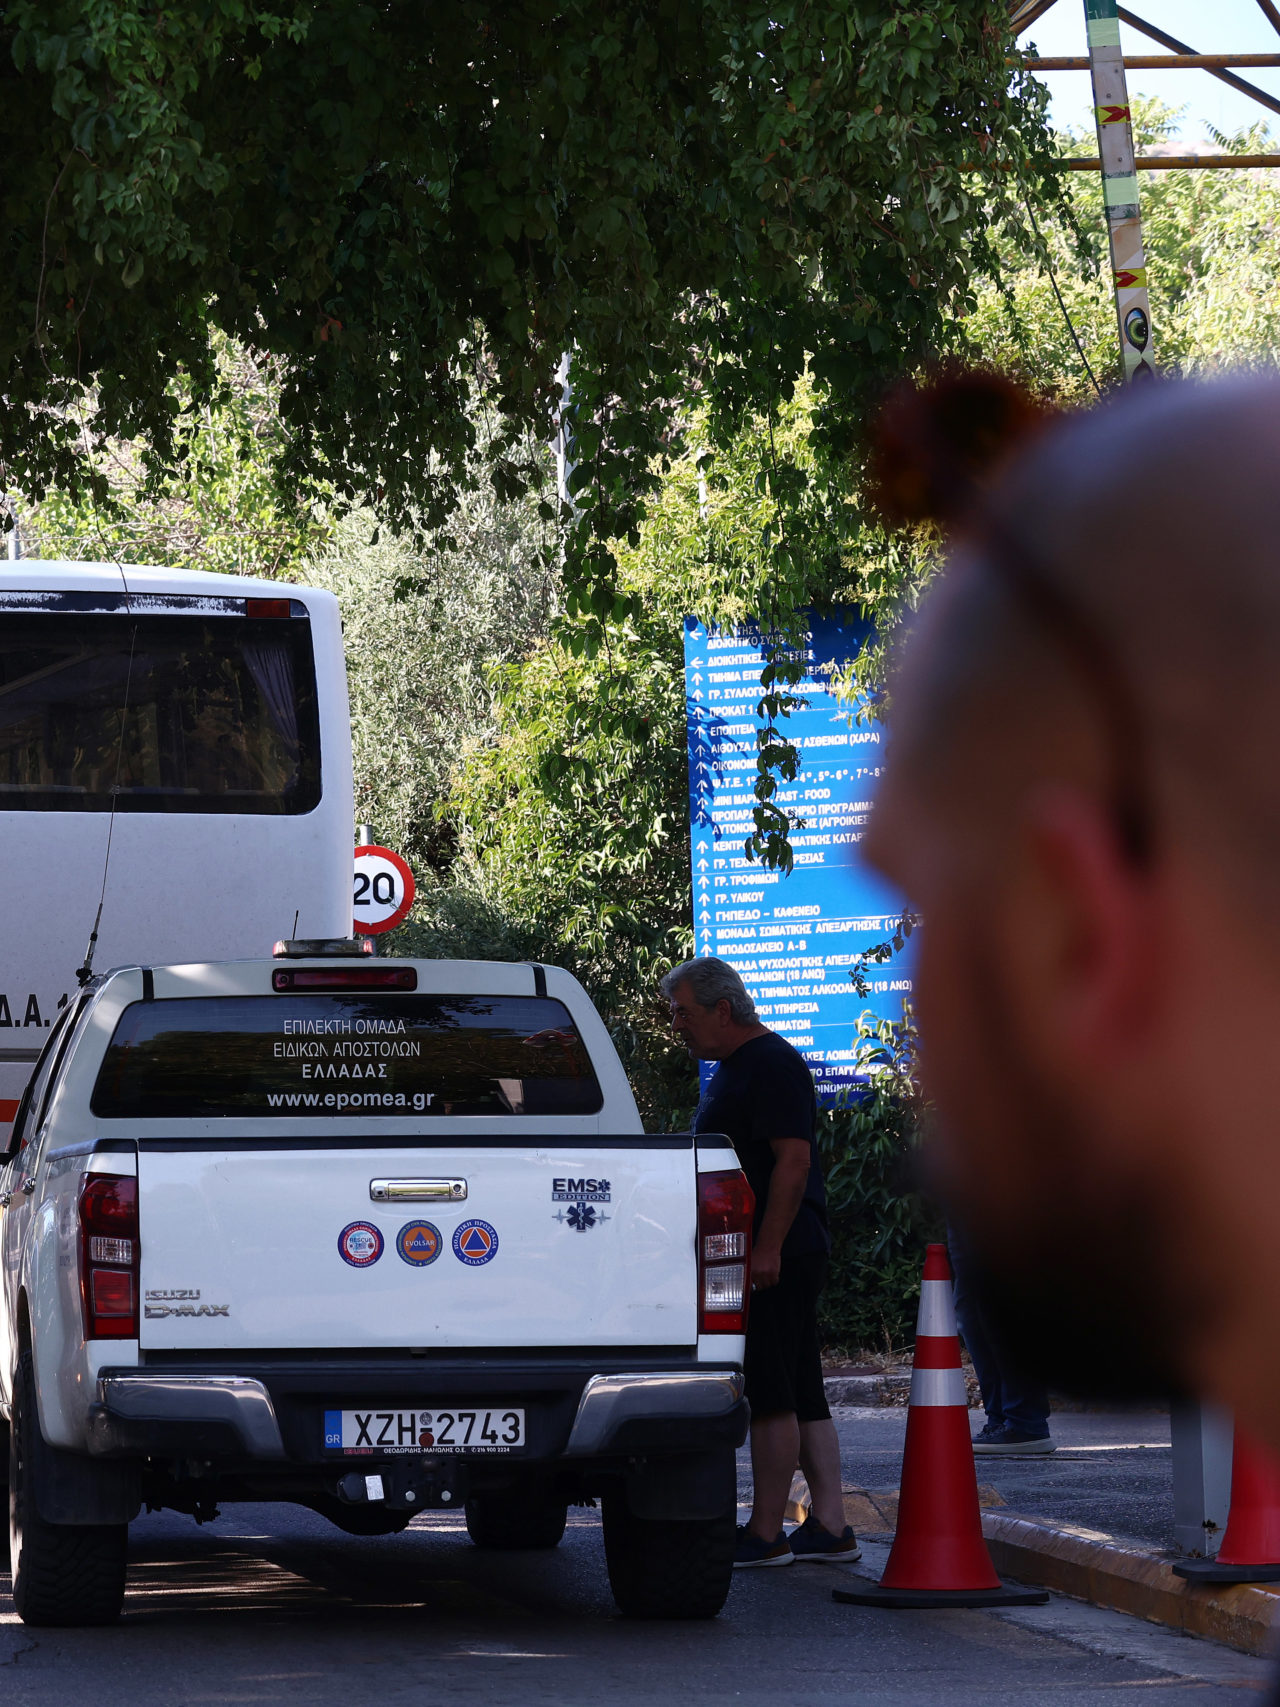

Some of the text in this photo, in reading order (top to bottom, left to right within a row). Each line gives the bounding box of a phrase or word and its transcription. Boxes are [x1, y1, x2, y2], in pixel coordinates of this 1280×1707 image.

[707, 653, 763, 667] ΔΙΟΙΚΗΤΙΚΕΣ
[708, 672, 741, 683] ΤΜΗΜΑ
[708, 689, 723, 700] ΓΡ.
[710, 704, 746, 717] ΠΡΟΚΑΤ
[710, 724, 756, 736] ΕΠΟΠΤΕΙΑ
[711, 741, 751, 753] ΑΙΘΟΥΣΑ
[804, 735, 848, 748] ΑΣΘΕΝΩΝ
[849, 732, 880, 747] (ΧΑΡΑ)
[775, 791, 798, 802] FAST
[805, 788, 831, 800] FOOD
[713, 858, 728, 869] ΓΡ.
[714, 873, 779, 887] ΓΡ. ΤΡΟΦΙΜΩΝ
[354, 872, 395, 905] 20
[715, 891, 765, 905] ΓΡ. ΥΛΙΚΟΥ
[715, 909, 760, 922] ΓΗΠΕΔΟ
[773, 905, 821, 918] ΚΑΦΕΝΕΙΟ
[716, 927, 757, 939] ΜΟΝΑΔΑ
[759, 923, 812, 937] ΣΩΜΑΤΙΚΗΣ
[815, 919, 882, 933] ΑΠΕΞΑΡΤΗΣΗΣ
[717, 941, 784, 955] ΜΠΟΔΟΣΑΚΕΙΟ
[758, 956, 824, 969] ΨΥΧΟΛΟΓΙΚΗΣ
[760, 985, 810, 998] ΤΜΗΜΑΤΟΣ
[774, 1002, 819, 1014] ΥΠΗΡΕΣΙΑ
[283, 1019, 406, 1035] ΕΠΙΛΕΚΤΗ ΟΜΑΔΑ
[273, 1041, 420, 1057] ΕΙΔΙΚΩΝ ΑΠΟΣΤΟΛΩΝ
[302, 1063, 388, 1079] ΕΛΛΑΔΑΣ
[267, 1092, 435, 1110] www.epomea.gr
[552, 1178, 598, 1193] EMS
[145, 1289, 200, 1300] ISUZU
[325, 1434, 340, 1444] GR
